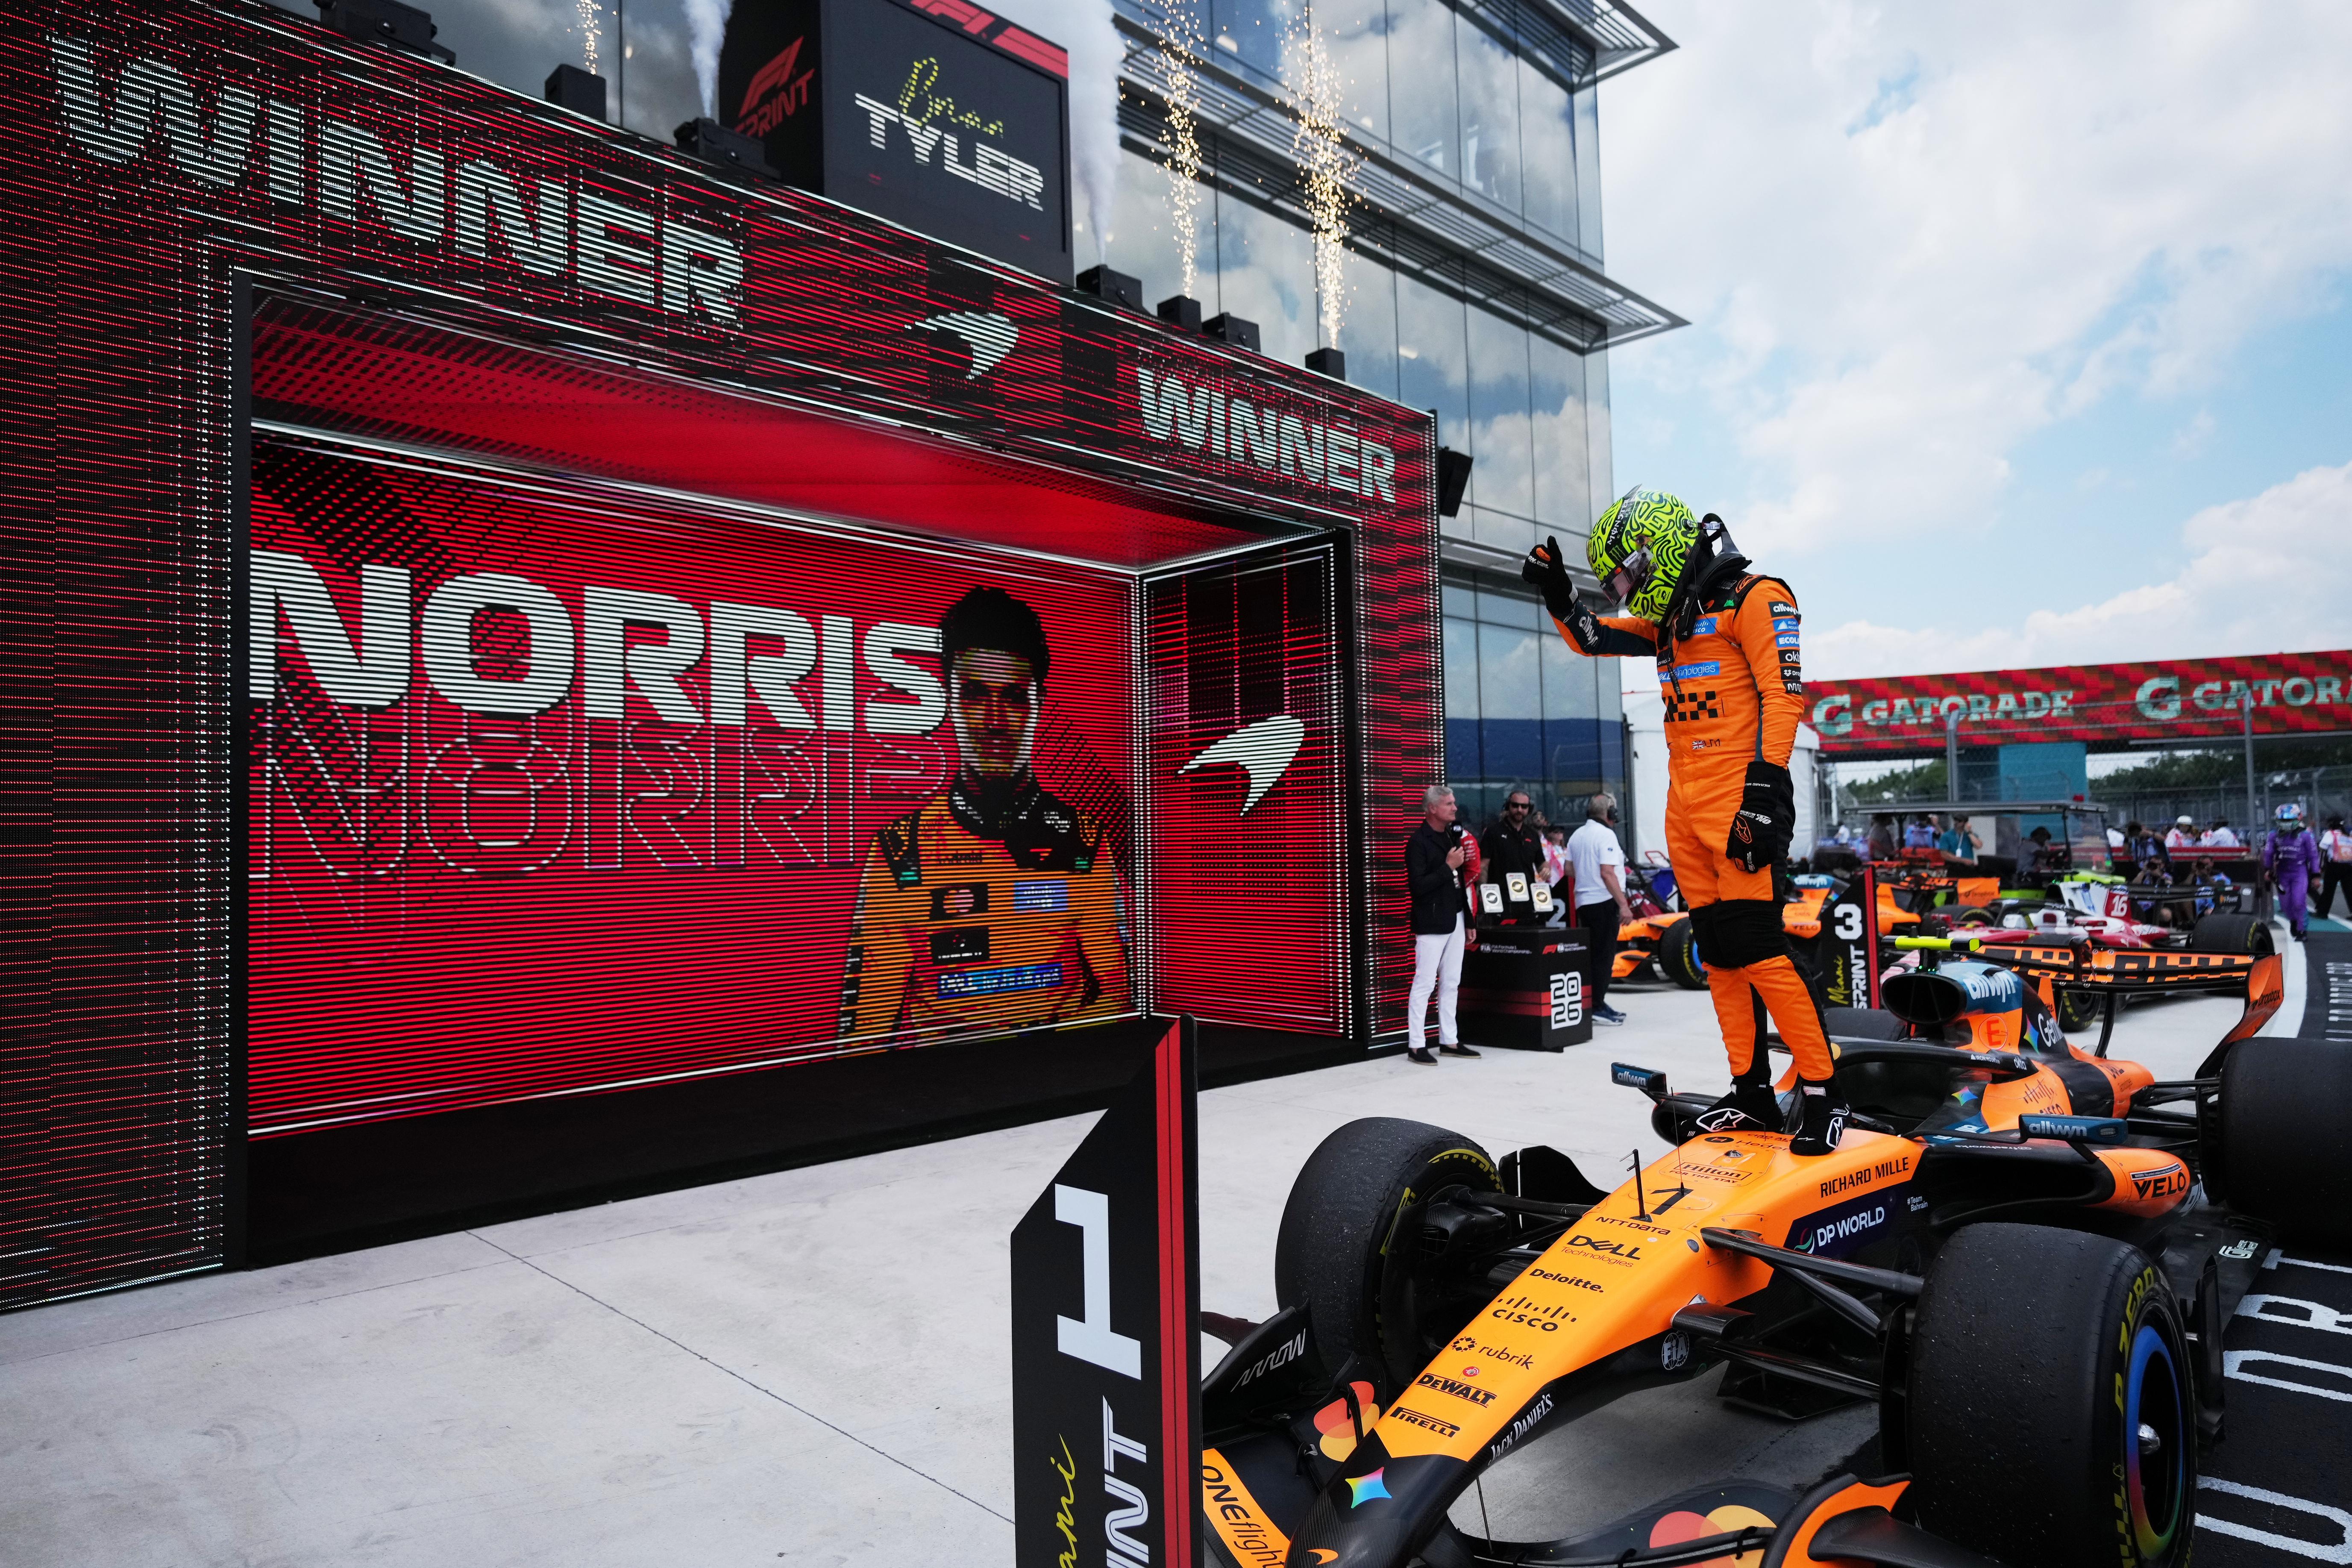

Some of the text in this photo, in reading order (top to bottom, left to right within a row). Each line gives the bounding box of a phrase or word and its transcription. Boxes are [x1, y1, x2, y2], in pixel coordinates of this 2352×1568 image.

[855, 93, 1043, 211] TYLER
[50, 34, 744, 329] WINNER
[1137, 367, 1396, 503] WINNER
[250, 549, 947, 734] NORRIS
[1862, 690, 2074, 726] GATORADE
[1545, 899, 1566, 929] 2
[1834, 903, 1863, 940] 3
[2111, 895, 2128, 917] 16
[1827, 954, 1850, 1004] Miami
[1850, 944, 1868, 1009] SPRINT
[1964, 969, 2016, 1003] allwyn
[1617, 1071, 1647, 1086] allwyn
[2028, 1120, 2087, 1138] allwyn
[1736, 1140, 1790, 1151] Heder
[1683, 1164, 1742, 1178] Hilton
[1821, 1157, 1910, 1198] RICHARD MILLE
[2133, 1172, 2186, 1200] VELO
[1649, 1187, 1694, 1216] 1
[1907, 1196, 1923, 1205] #Team
[1911, 1201, 1928, 1212] Bahrain
[1817, 1207, 1885, 1248] DP WORLD
[1561, 1246, 1634, 1268] Technologies
[1566, 1234, 1642, 1260] DELL
[1055, 1183, 1141, 1380] 1
[1529, 1268, 1604, 1293] Deloitte.
[1479, 1345, 1534, 1370] rubrik
[1389, 1406, 1461, 1438] PIRELLI
[1488, 1432, 1513, 1467] JACK
